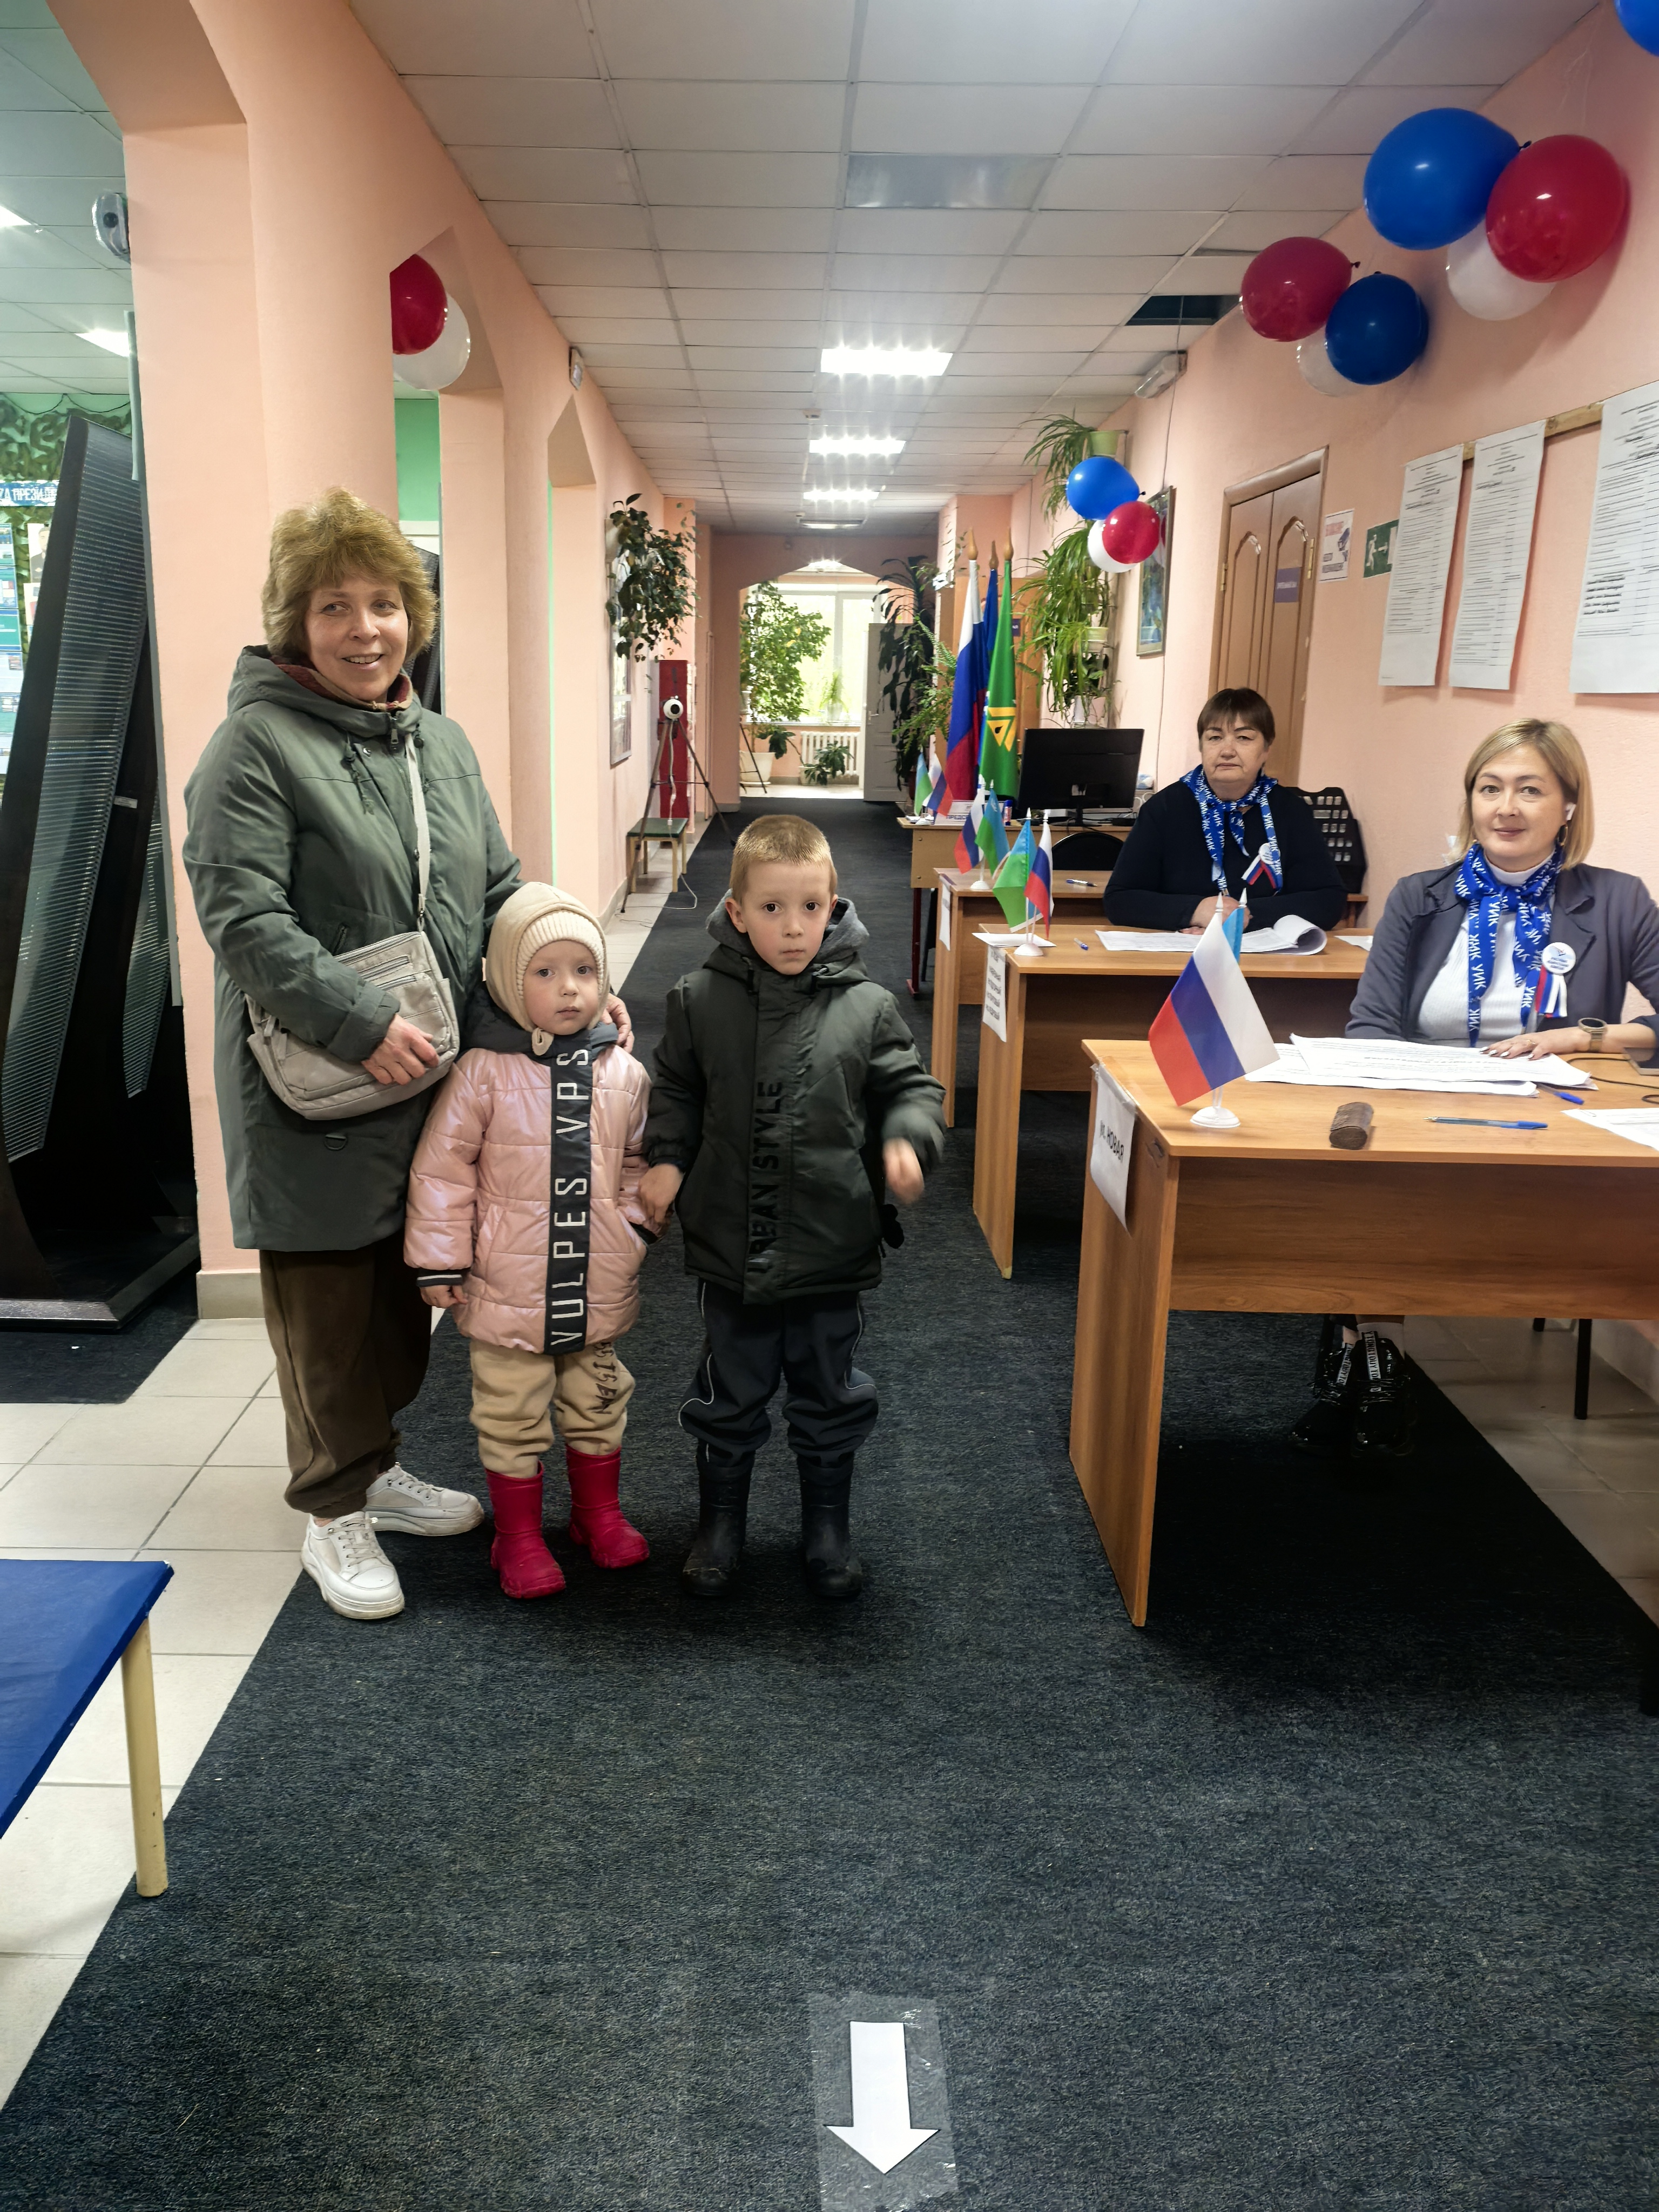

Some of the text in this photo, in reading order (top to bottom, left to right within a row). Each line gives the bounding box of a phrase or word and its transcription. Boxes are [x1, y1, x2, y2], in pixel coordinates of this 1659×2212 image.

[13, 488, 57, 501] ПРЕЗИ
[1488, 901, 1501, 927] УИК
[1471, 963, 1487, 990] УИК
[1521, 986, 1537, 1008] УИК
[1468, 1008, 1481, 1032] УИК
[752, 1081, 783, 1170] STYLE
[550, 1048, 590, 1347] VULPES VPS
